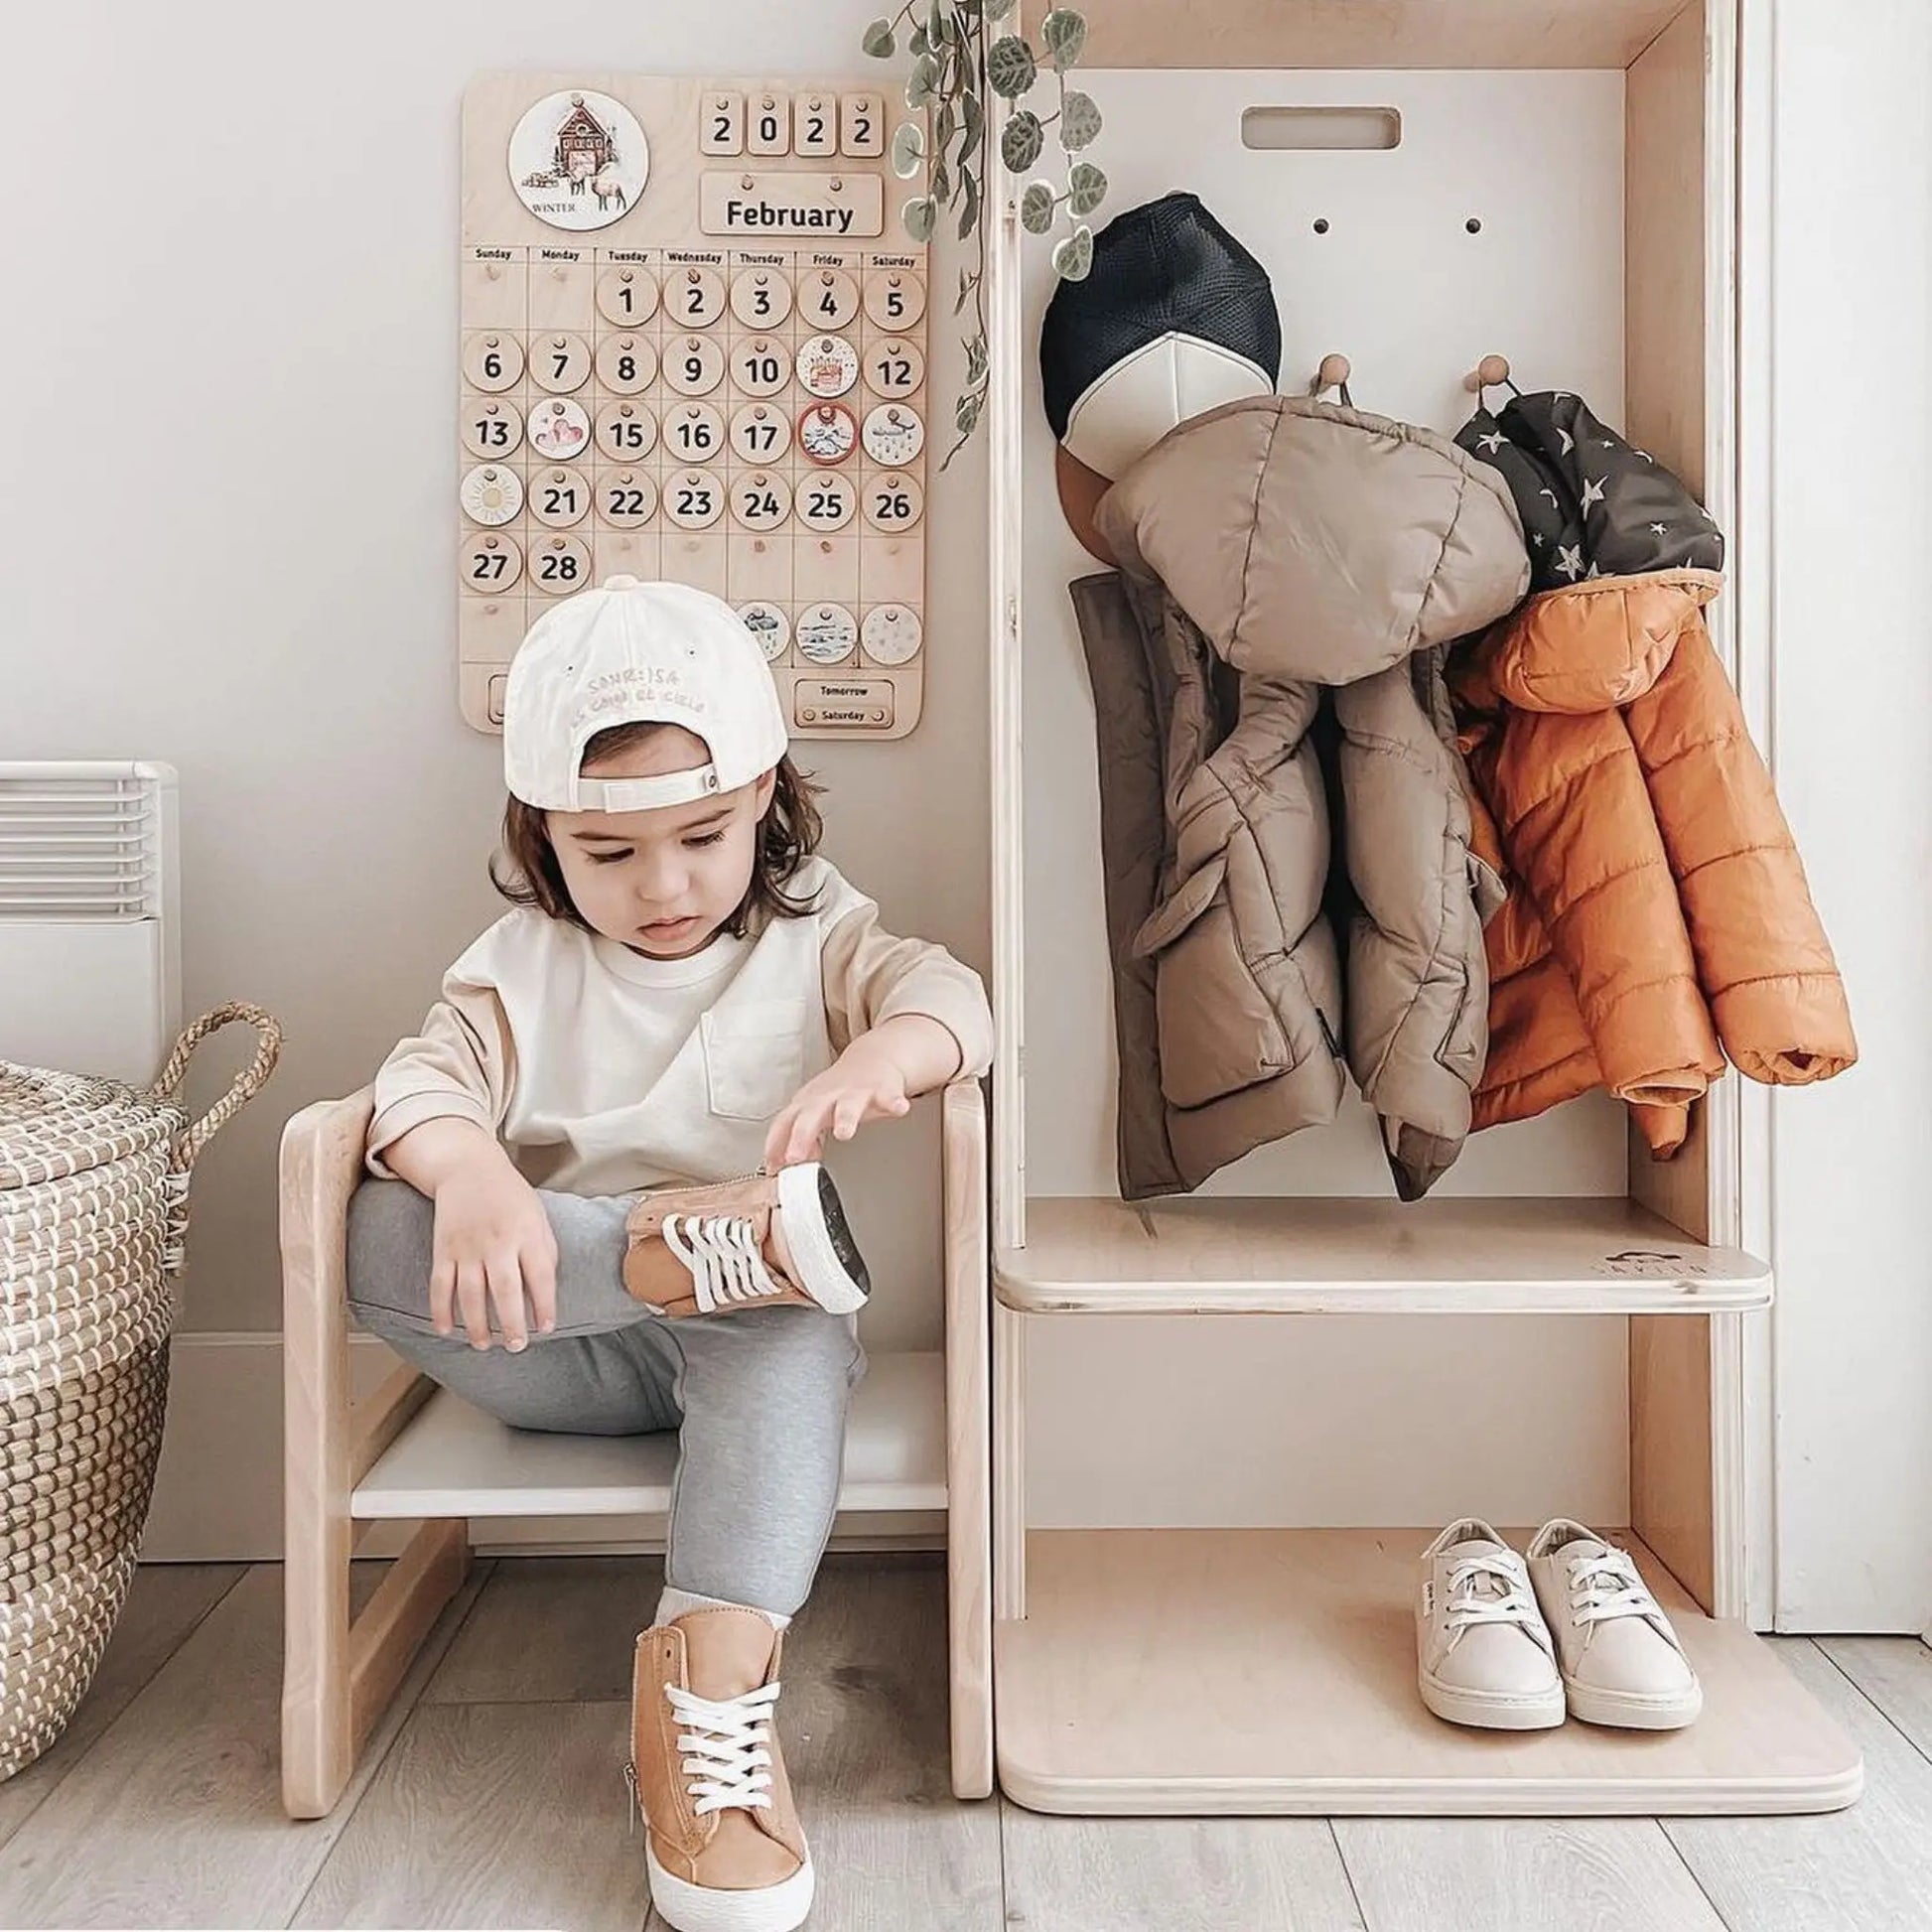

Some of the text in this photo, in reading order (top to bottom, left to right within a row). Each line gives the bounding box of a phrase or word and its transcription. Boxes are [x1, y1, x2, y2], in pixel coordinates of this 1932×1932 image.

[531, 203, 576, 214] WINTER
[727, 201, 854, 234] February
[476, 248, 915, 268] Sunday Monday Tuesday Wednesday Thursday Friday Saturday
[619, 288, 904, 317] 1 2 3 4 5
[484, 352, 911, 385] 6 7 8 9 10 12
[475, 420, 777, 451] 13 15 16 17
[543, 488, 910, 519] 21 22 23 24 25 26
[473, 553, 578, 581] 27 28
[820, 686, 868, 696] Tomorrow
[822, 711, 865, 722] Saturday
